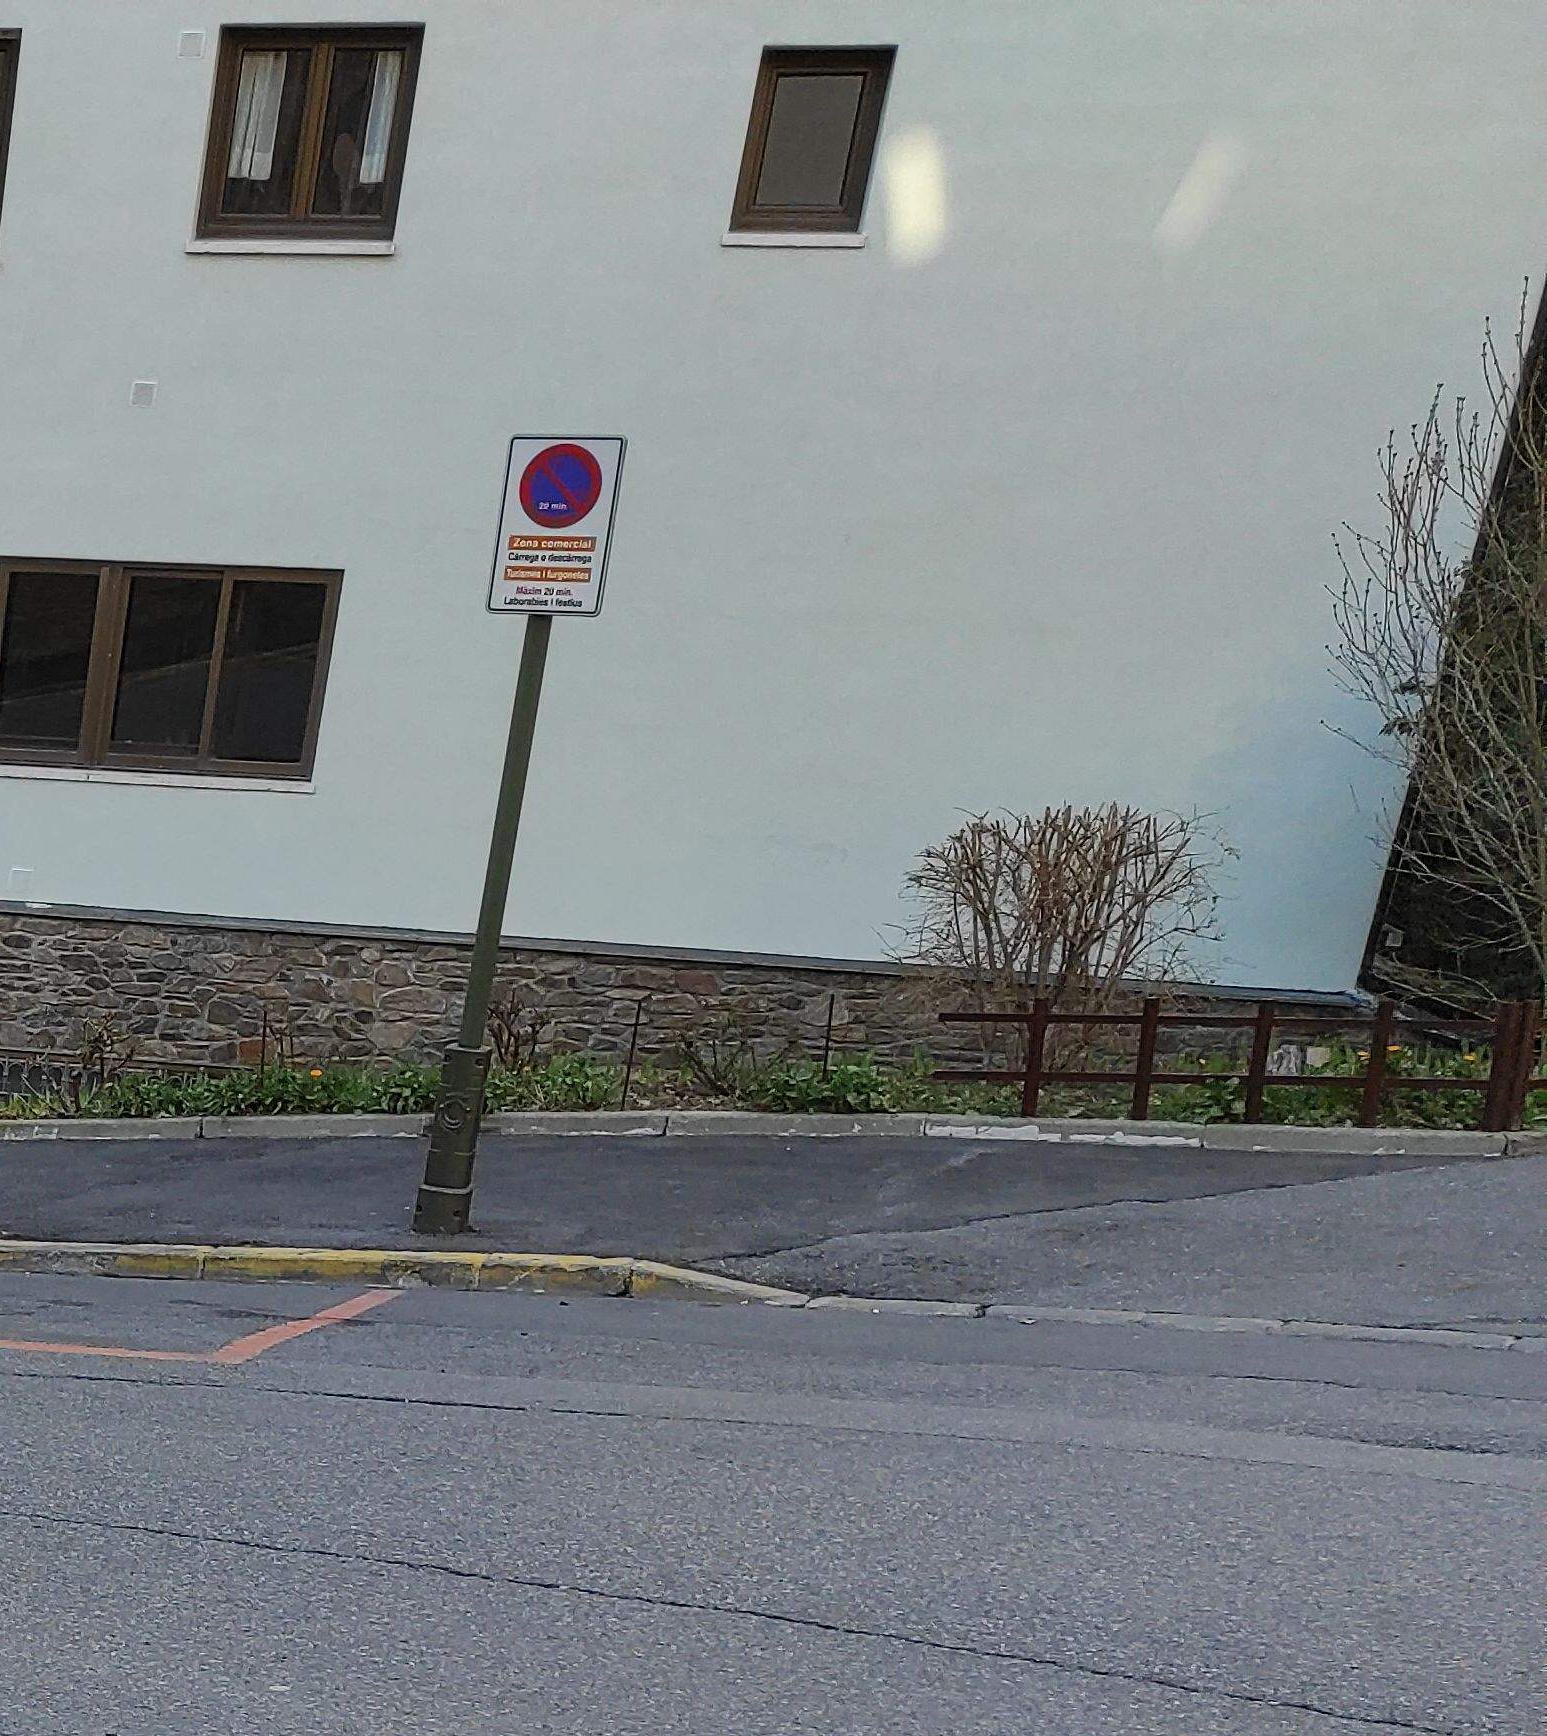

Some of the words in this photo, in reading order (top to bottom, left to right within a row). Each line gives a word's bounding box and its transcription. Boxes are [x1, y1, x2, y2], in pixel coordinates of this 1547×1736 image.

[513, 537, 539, 548] Zona
[541, 539, 592, 549] comercial
[547, 569, 589, 580] furgonetes
[504, 596, 548, 606] Laborables
[555, 598, 582, 607] festius
